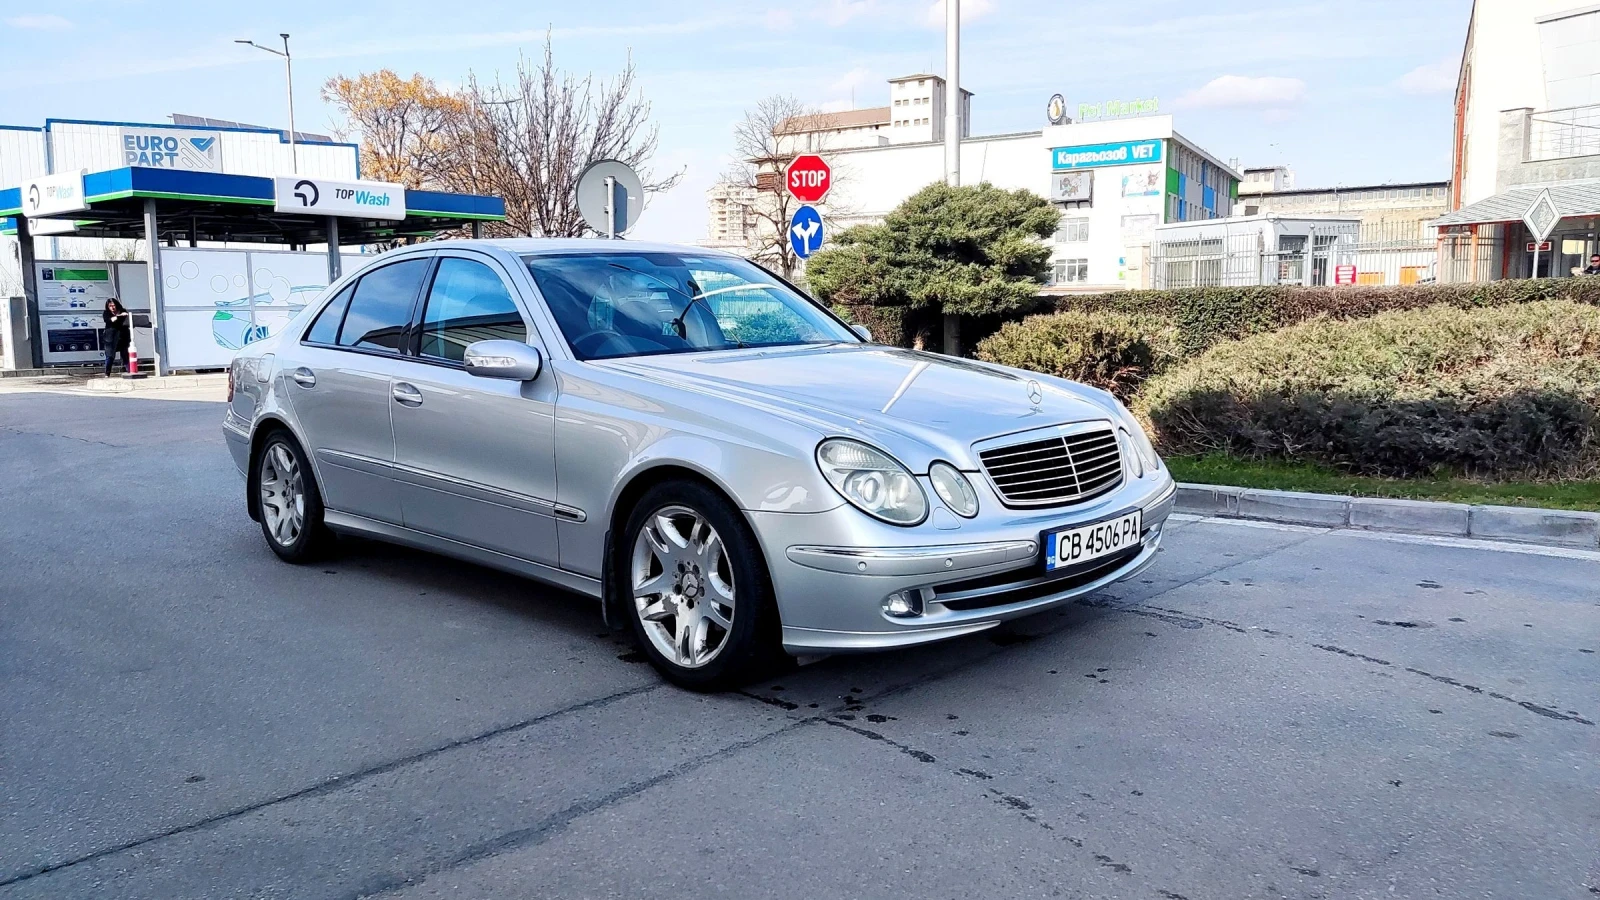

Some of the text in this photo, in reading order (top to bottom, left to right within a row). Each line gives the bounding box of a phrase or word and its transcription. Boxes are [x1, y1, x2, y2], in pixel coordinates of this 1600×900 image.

[1079, 96, 1158, 118] Pet Market
[124, 135, 178, 151] EURO
[125, 151, 179, 167] PART
[1057, 144, 1155, 166] Карагьозов VET
[791, 170, 827, 188] STOP
[335, 188, 390, 207] TOP Wash
[1059, 516, 1138, 562] CB 4506 PA
